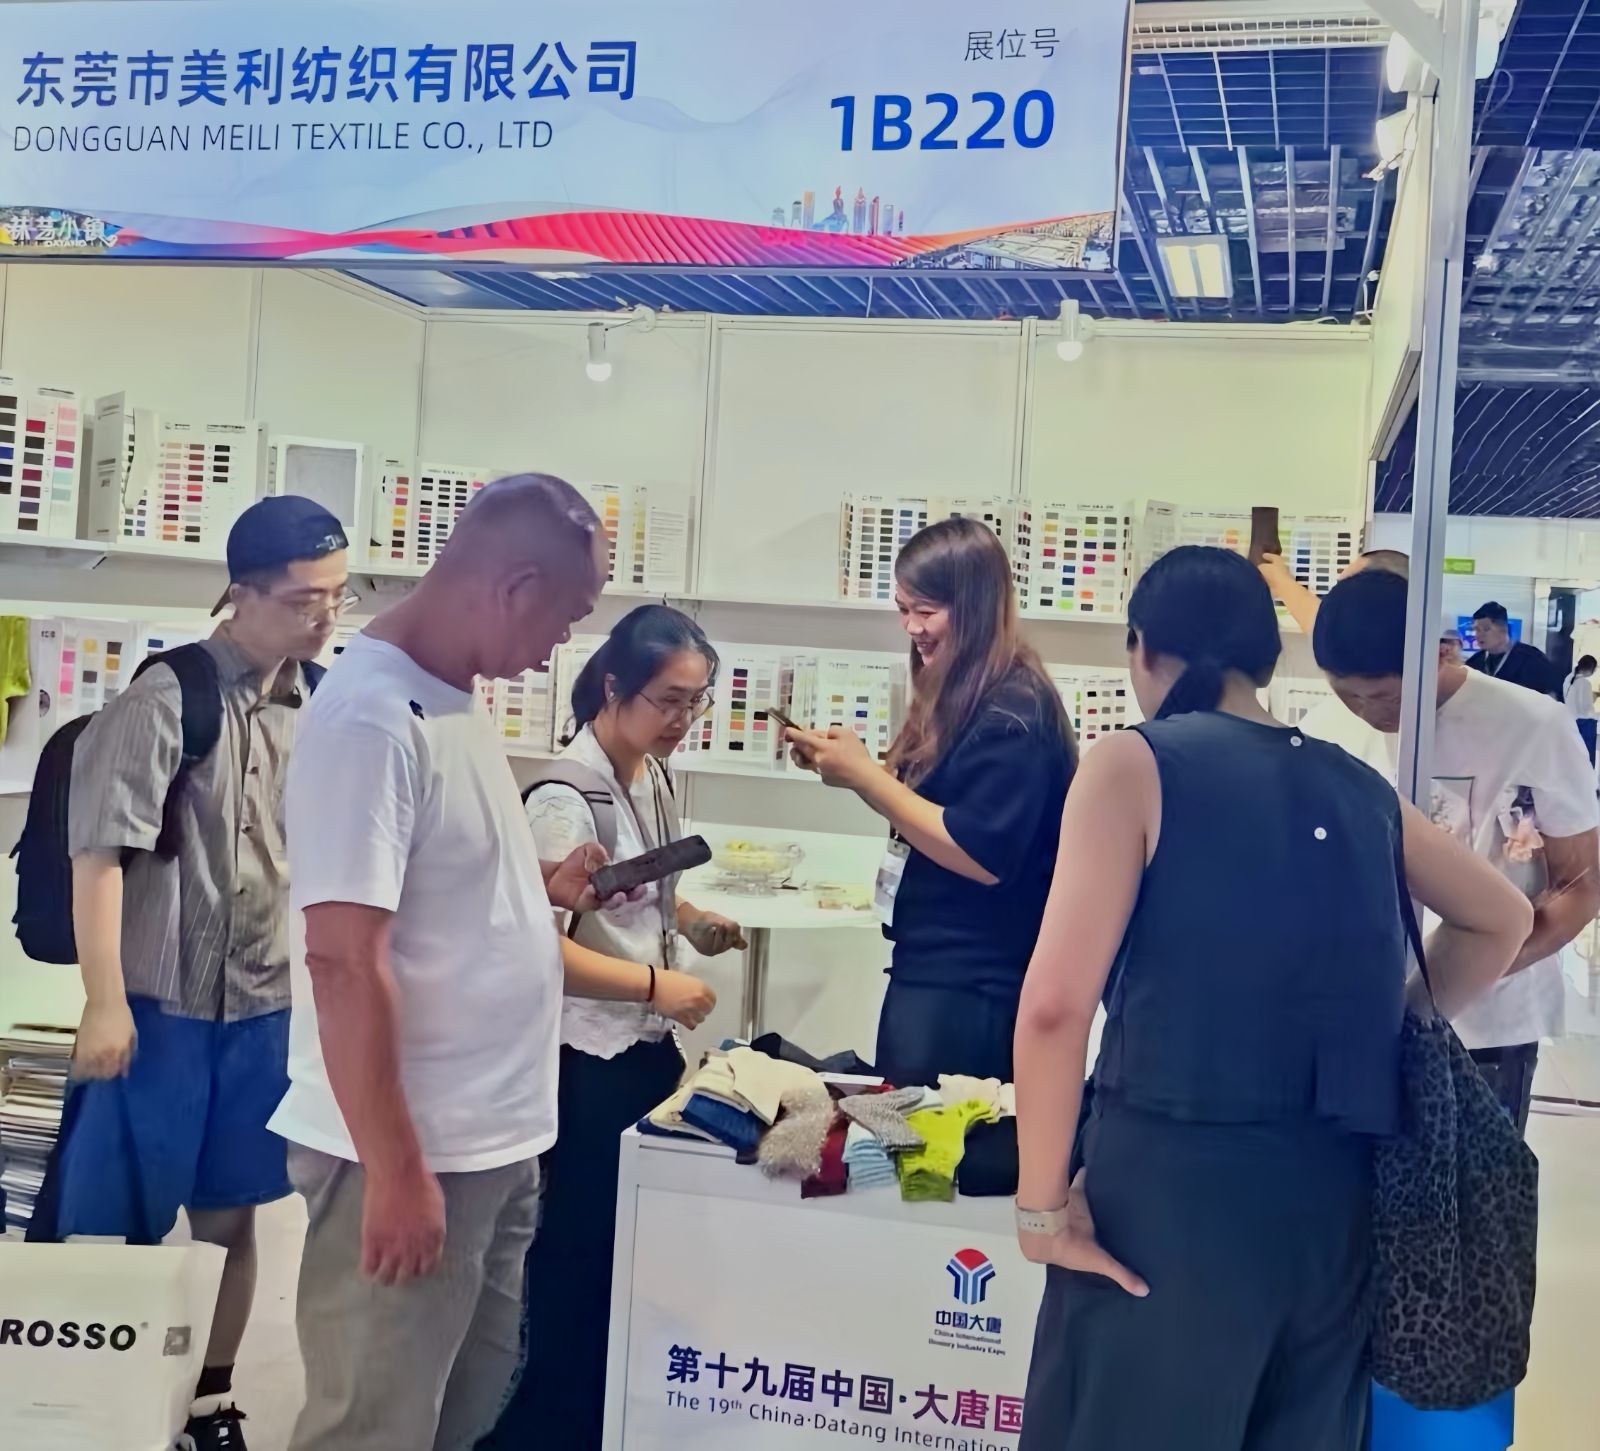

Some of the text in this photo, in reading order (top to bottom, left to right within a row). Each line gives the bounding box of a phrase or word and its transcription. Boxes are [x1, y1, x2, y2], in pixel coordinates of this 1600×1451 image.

[964, 28, 1060, 61] 展位号
[17, 41, 636, 108] 东莞市美利纺织有限公司
[831, 90, 1055, 151] 1B220
[14, 121, 553, 154] DONGGUAN MEILI TEXTILE CO., LTD
[0, 1319, 136, 1351] ROSSO
[667, 1391, 700, 1411] The
[709, 1397, 742, 1414] 19th
